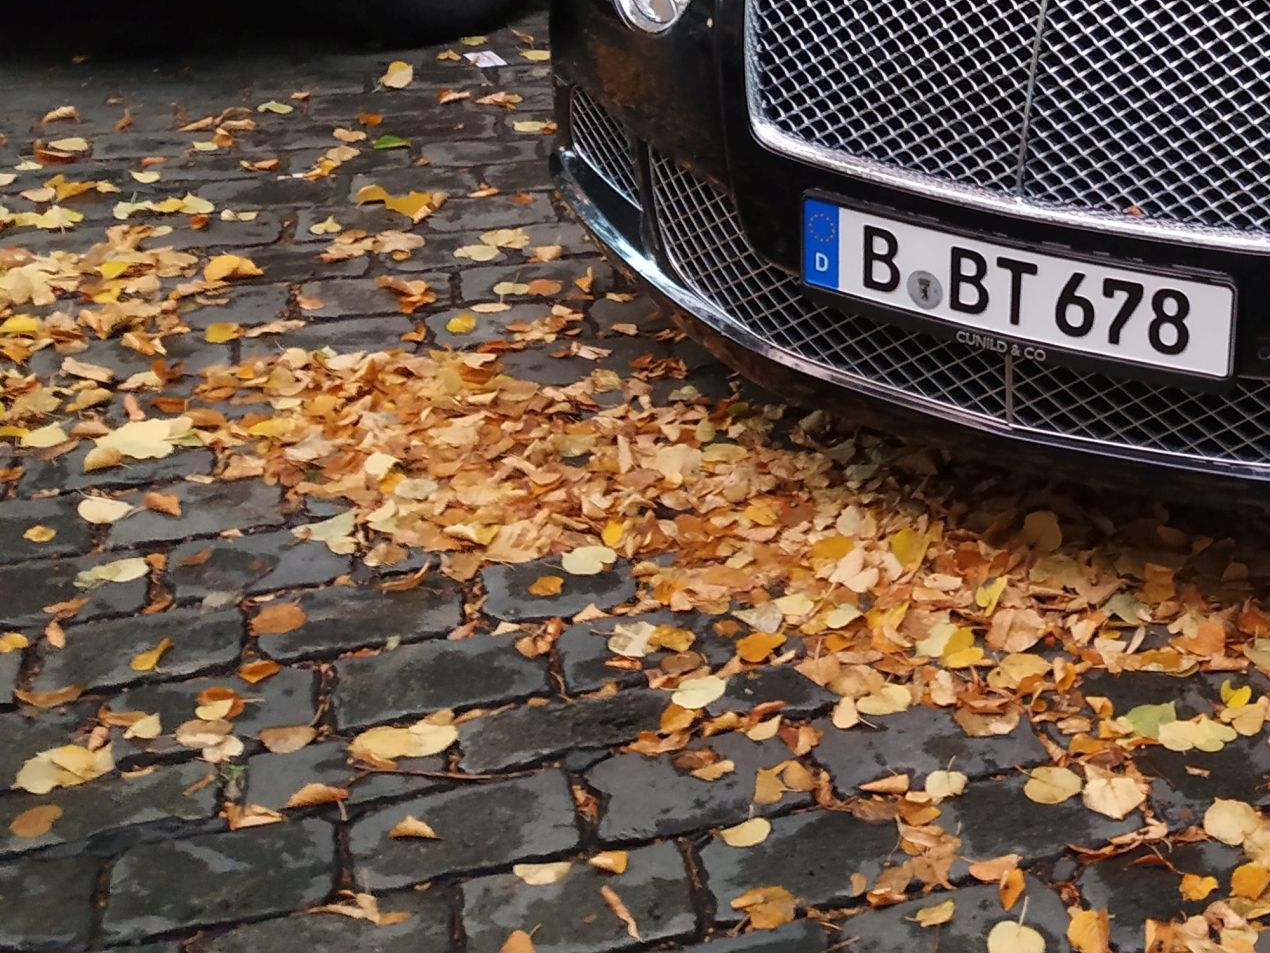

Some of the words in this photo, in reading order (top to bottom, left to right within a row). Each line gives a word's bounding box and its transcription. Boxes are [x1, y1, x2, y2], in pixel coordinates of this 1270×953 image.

[815, 252, 829, 272] D
[863, 224, 901, 293] B
[949, 246, 1038, 326] BT
[1055, 272, 1190, 356] 678
[1010, 344, 1020, 356] &
[1024, 347, 1047, 362] CO
